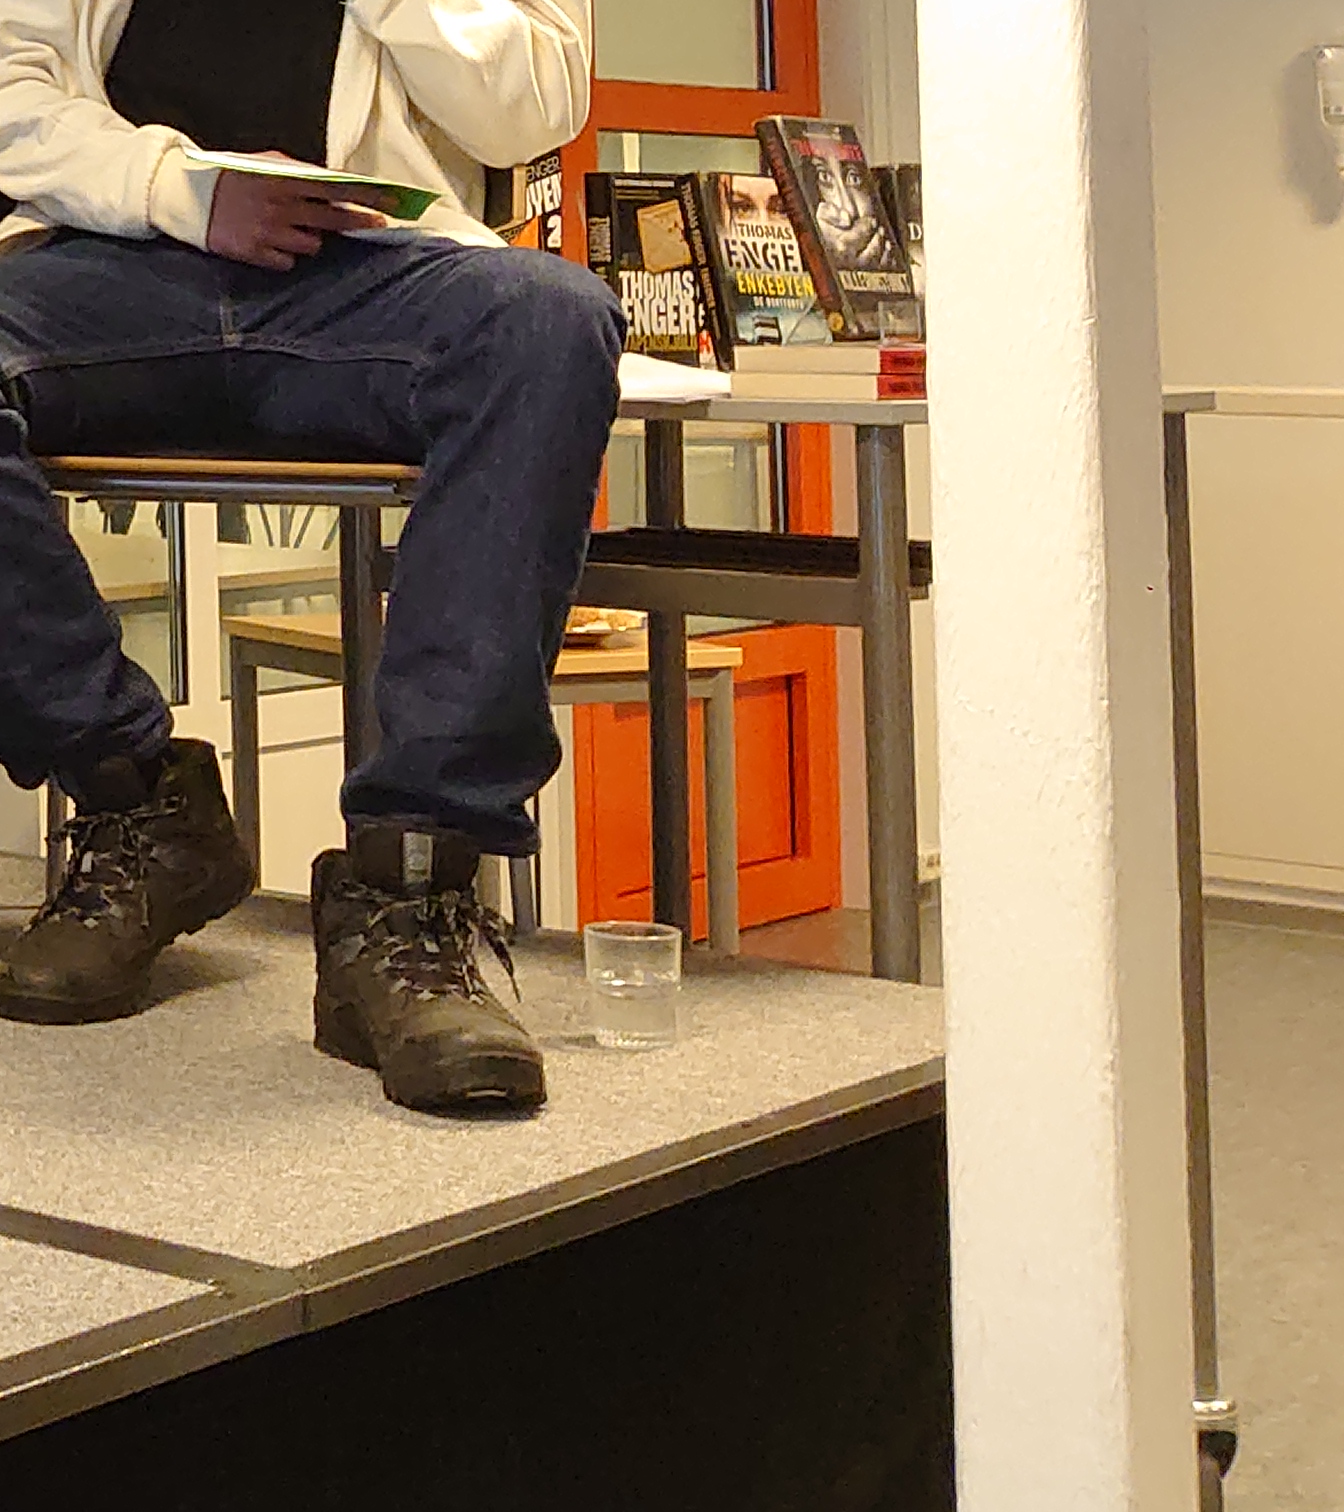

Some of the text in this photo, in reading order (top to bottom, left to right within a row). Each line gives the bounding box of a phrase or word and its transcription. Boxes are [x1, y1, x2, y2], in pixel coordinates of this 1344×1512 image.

[737, 222, 792, 240] THOMAS
[618, 270, 695, 300] THOMAS
[736, 271, 815, 297] ENKEBYEN
[621, 297, 697, 336] ENGER
